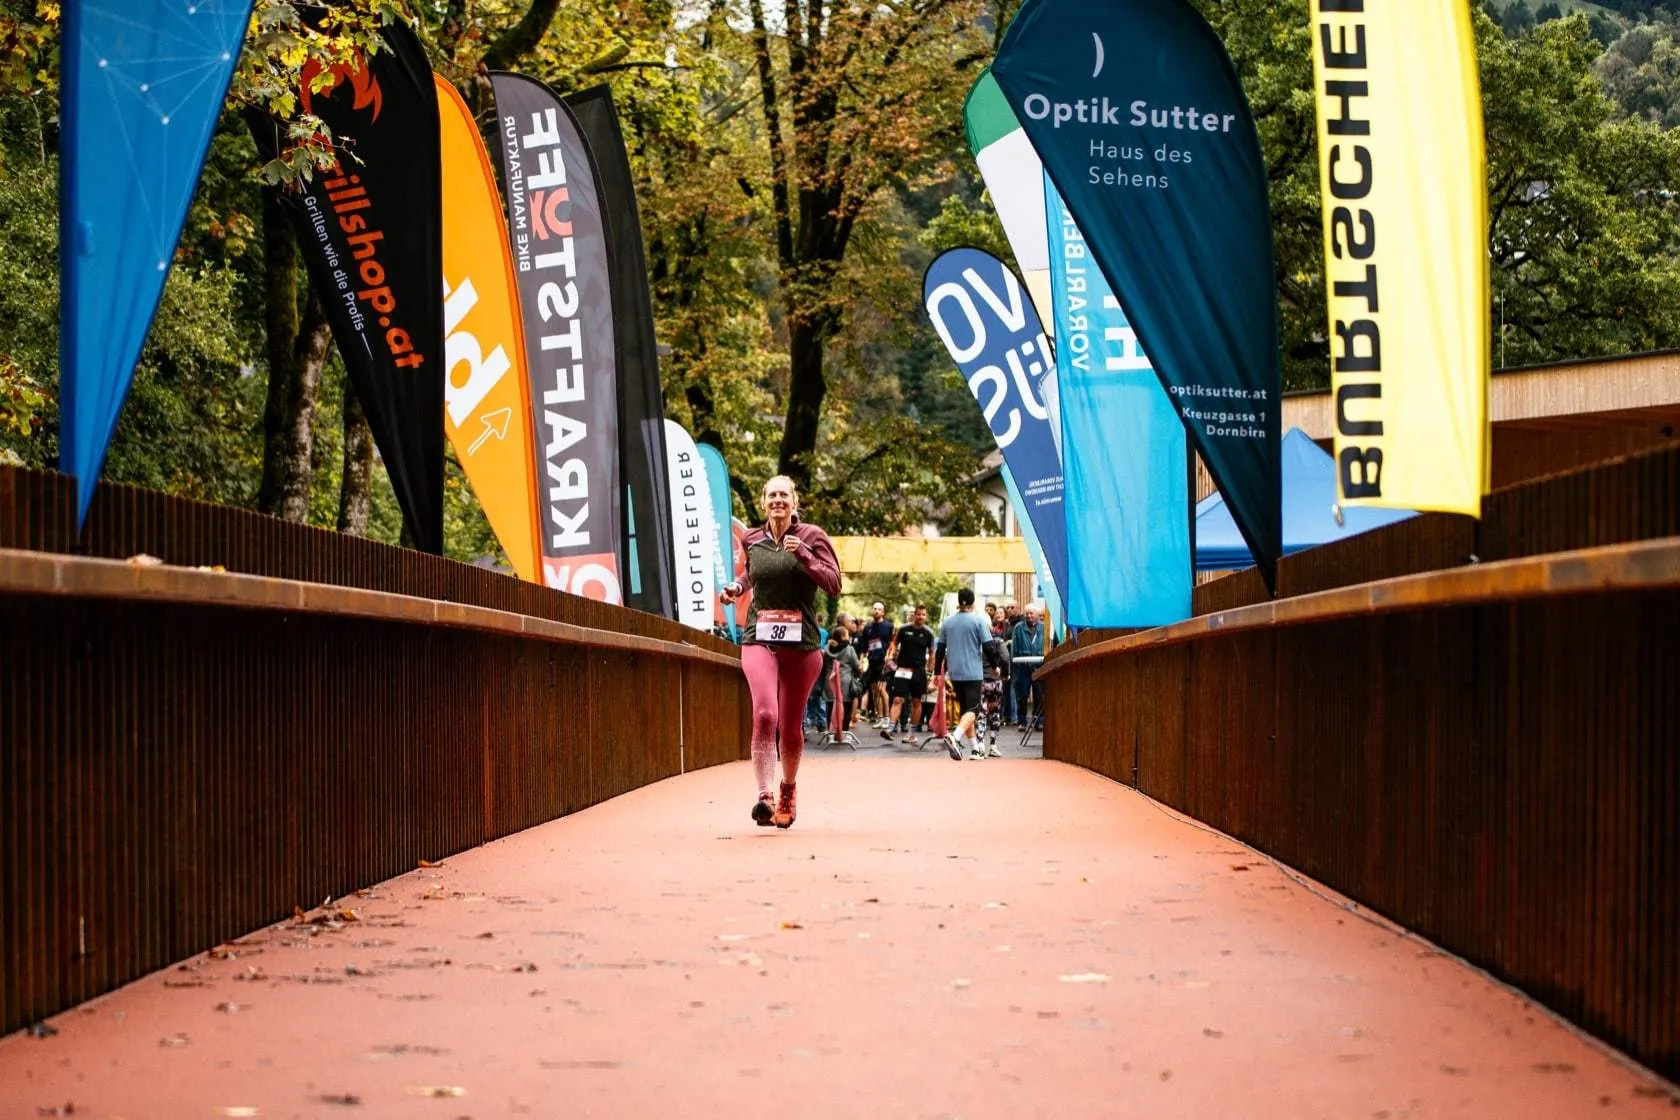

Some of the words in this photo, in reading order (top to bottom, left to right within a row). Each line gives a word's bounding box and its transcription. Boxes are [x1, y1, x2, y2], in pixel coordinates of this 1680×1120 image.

[1023, 93, 1119, 128] Optik
[1129, 100, 1235, 132] Sutter
[1089, 139, 1144, 160] Haus
[1153, 144, 1192, 164] des
[1088, 166, 1169, 189] Sehens
[304, 195, 329, 244] Grillen
[323, 243, 339, 268] wie
[333, 267, 348, 291] die
[343, 291, 365, 332] Profis
[1169, 384, 1267, 400] optiksutter.at
[1182, 407, 1256, 423] Kreuzgasse
[1259, 411, 1266, 422] 1
[1206, 424, 1266, 438] Dornbirn
[771, 624, 787, 640] 38
